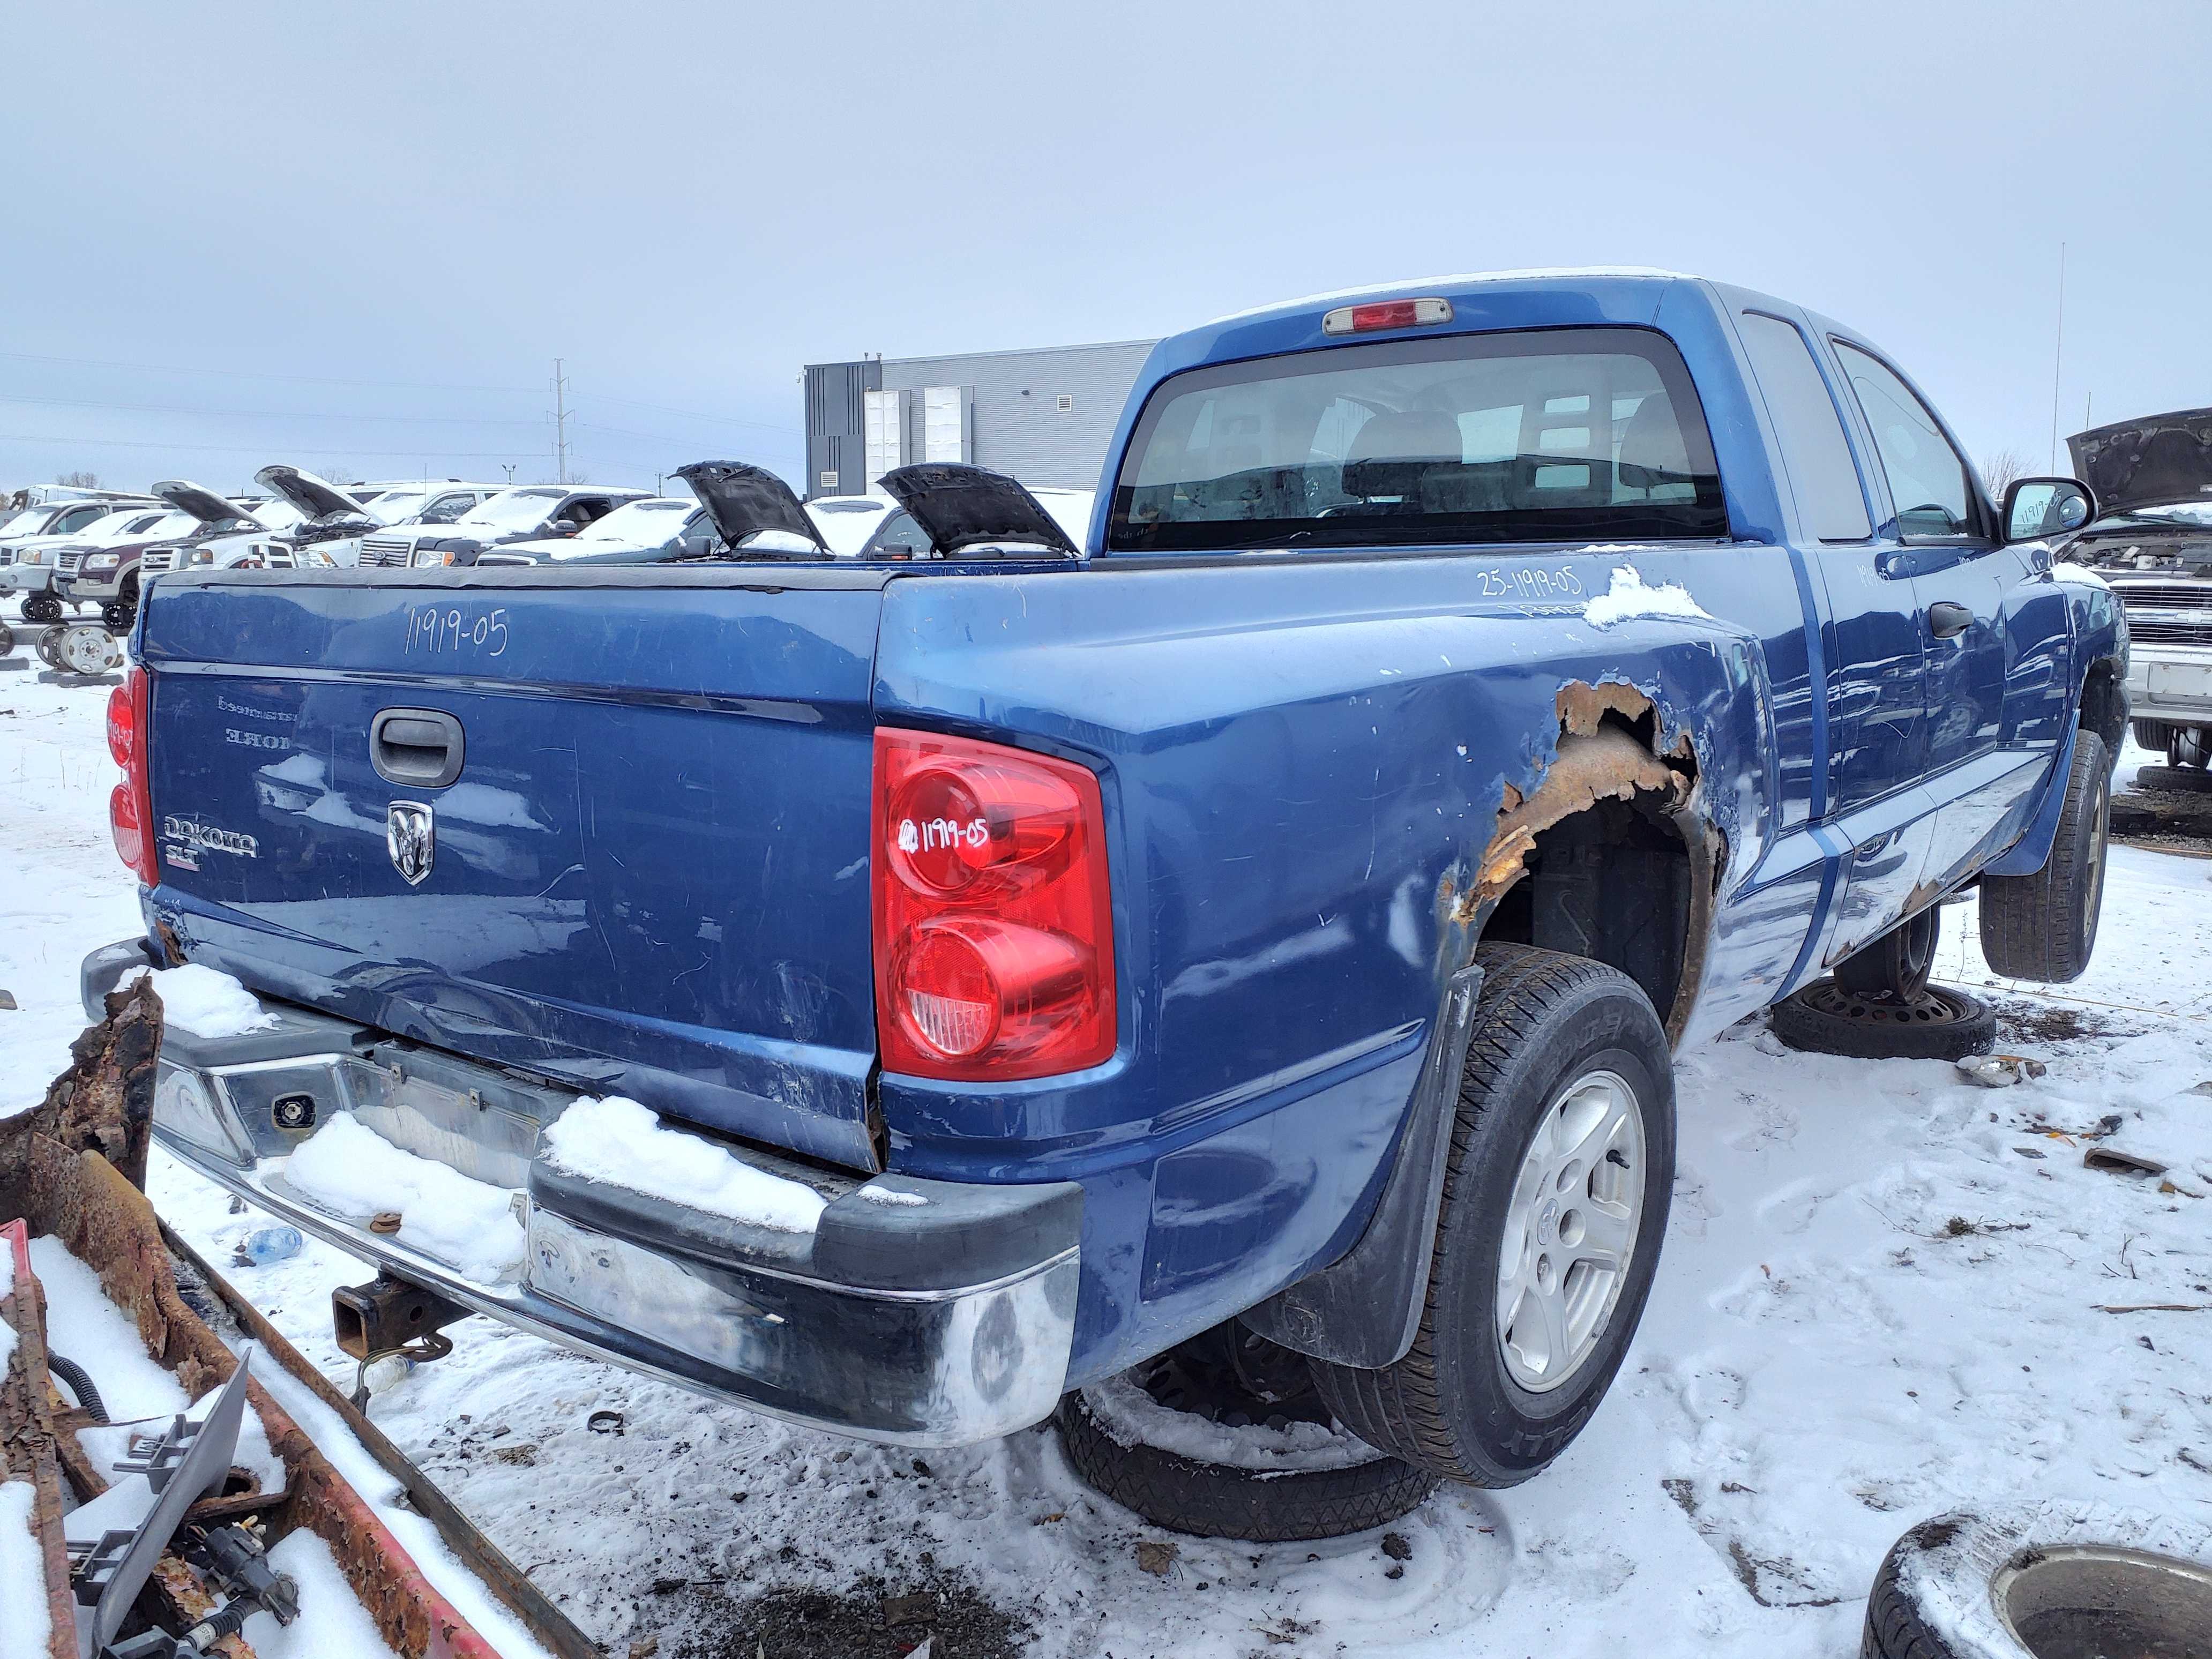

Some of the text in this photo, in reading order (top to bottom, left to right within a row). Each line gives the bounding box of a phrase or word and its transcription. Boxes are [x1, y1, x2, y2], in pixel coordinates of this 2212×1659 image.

[2021, 489, 2062, 523] 11919-05
[1477, 565, 1582, 597] 25-11919-05
[405, 608, 508, 656] 11919-05
[164, 816, 259, 858] DAKOTA
[921, 818, 989, 853] 11919-05
[166, 845, 202, 866] SLT
